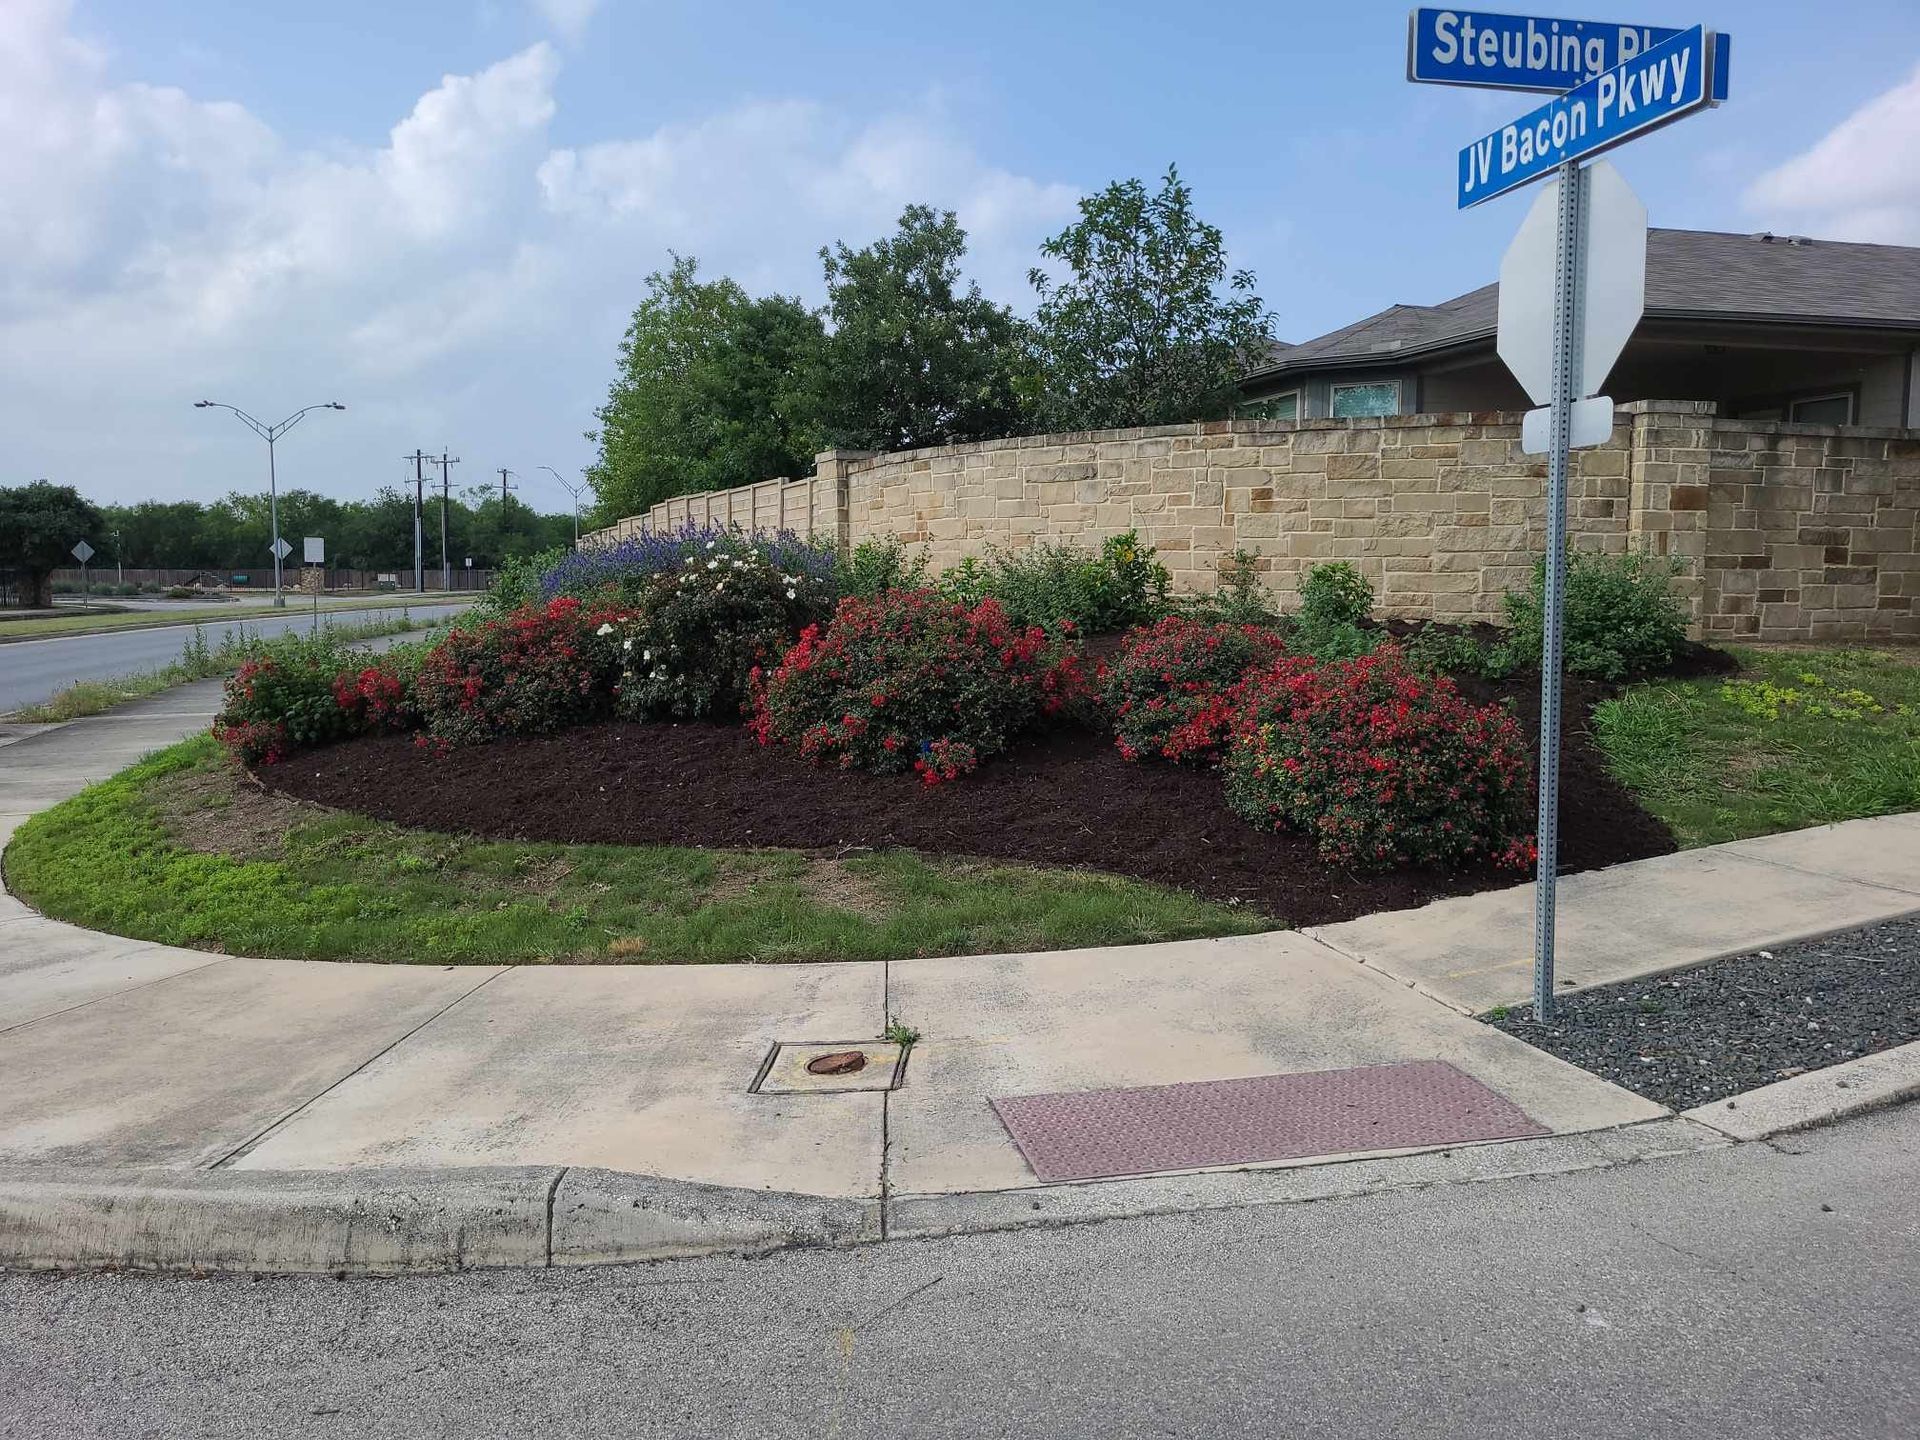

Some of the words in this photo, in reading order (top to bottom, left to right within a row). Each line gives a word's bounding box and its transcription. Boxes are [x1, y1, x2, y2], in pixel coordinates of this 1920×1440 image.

[1432, 11, 1605, 82] Steubing
[1464, 136, 1493, 193] JV
[1501, 99, 1586, 175] Bacon
[1597, 46, 1690, 128] Pkwy
